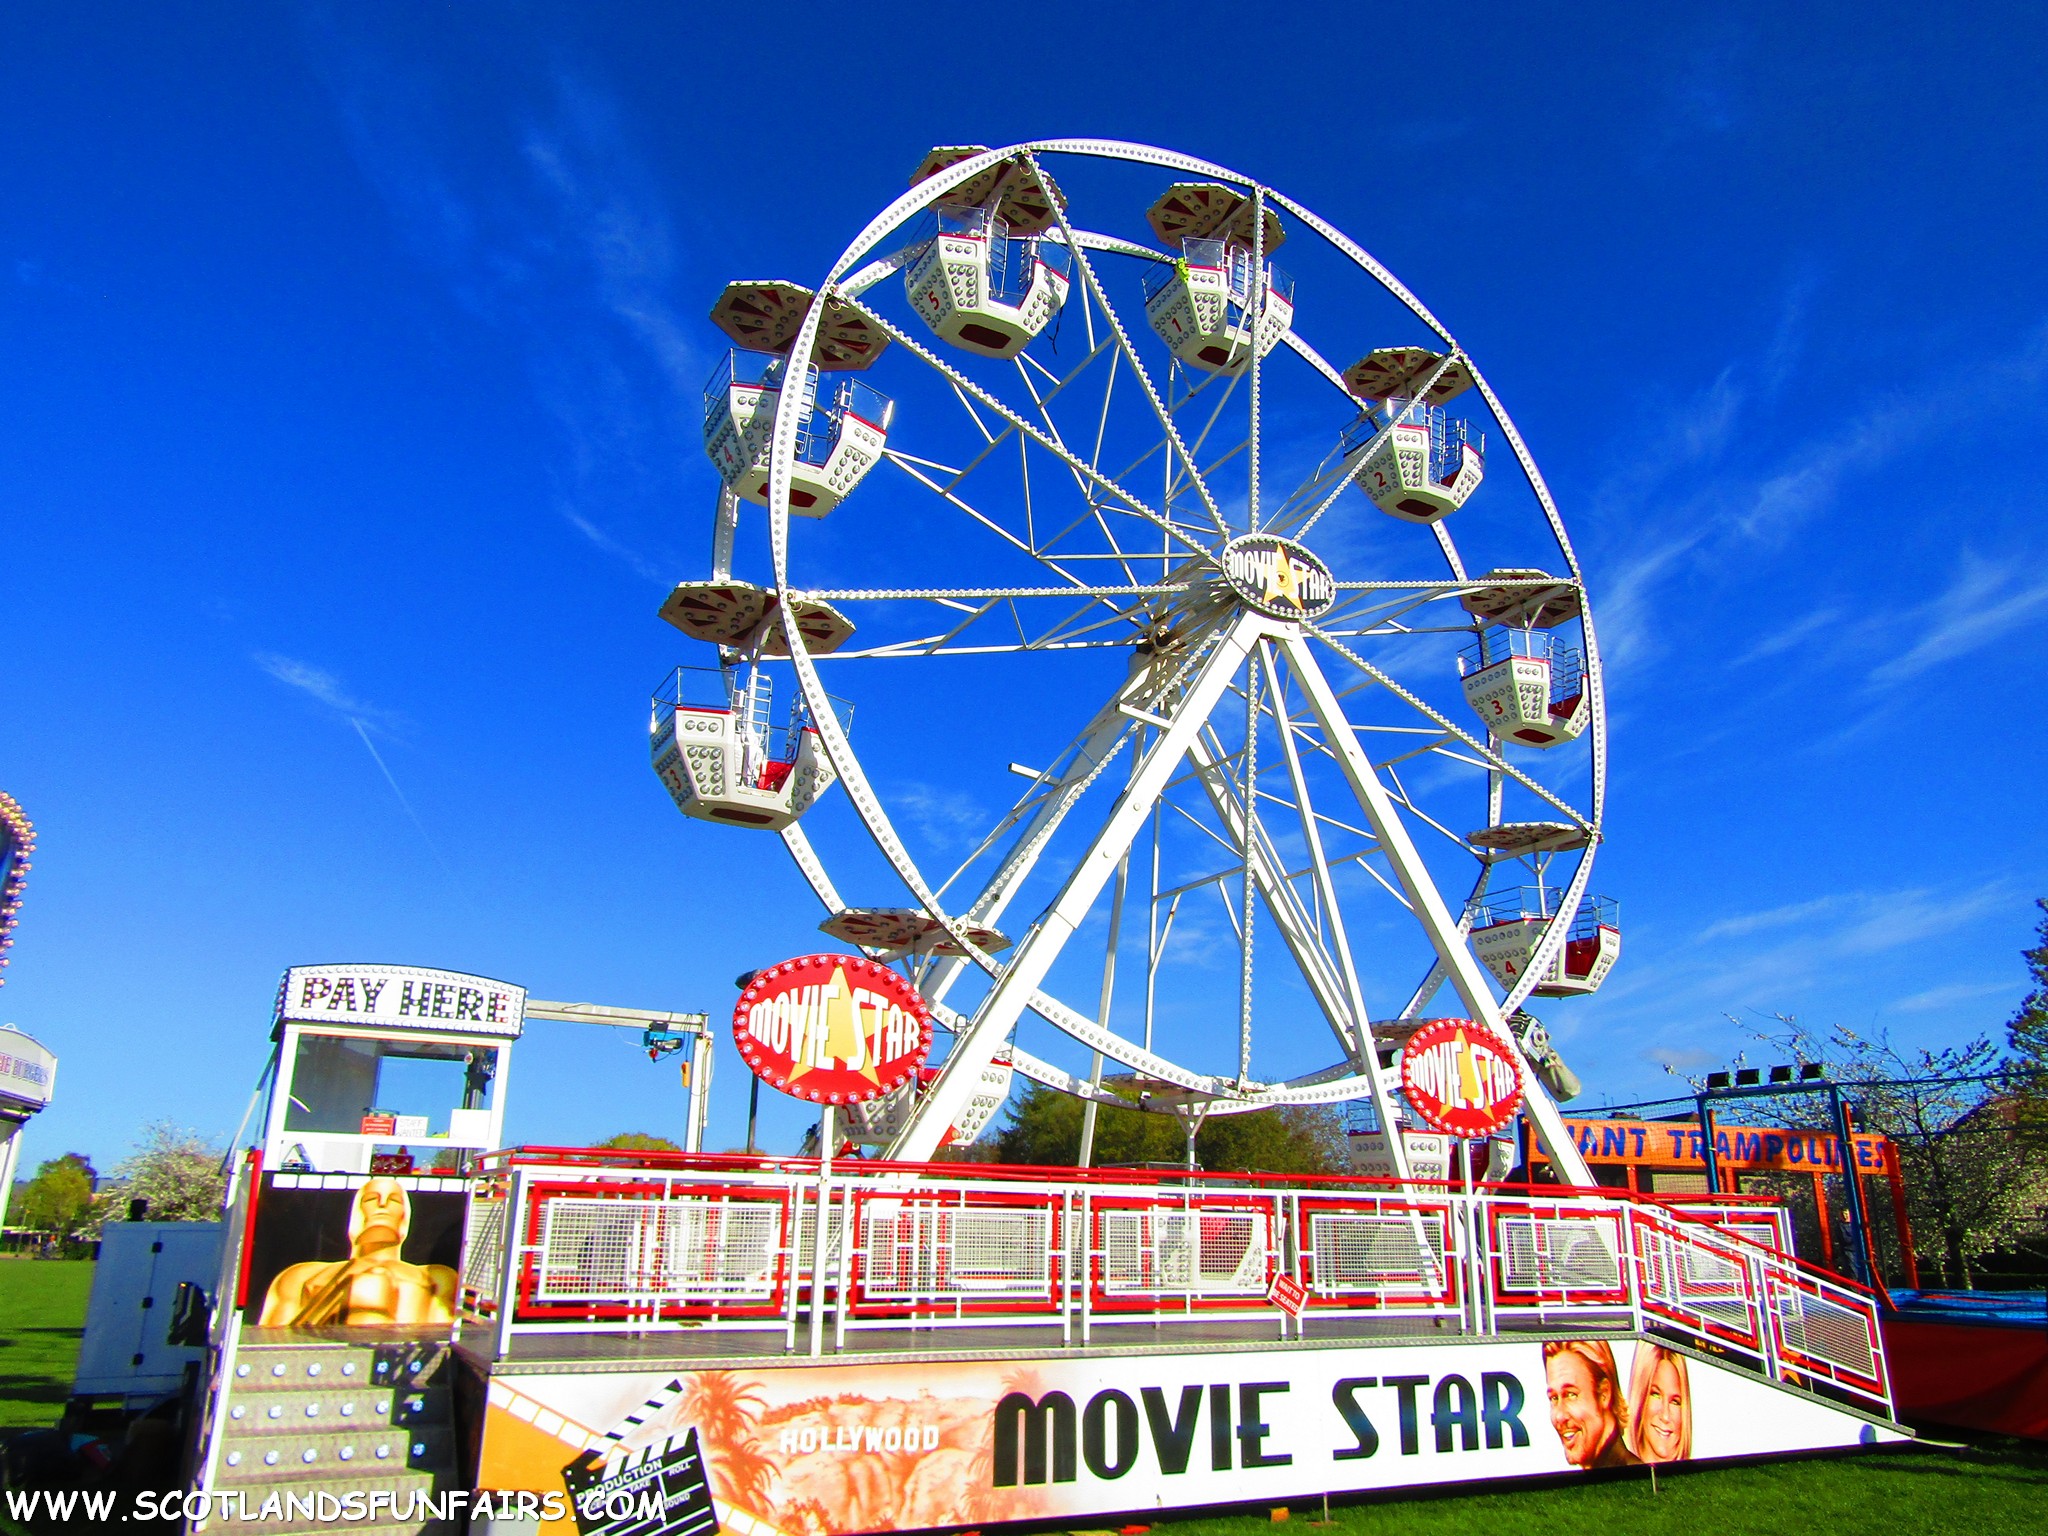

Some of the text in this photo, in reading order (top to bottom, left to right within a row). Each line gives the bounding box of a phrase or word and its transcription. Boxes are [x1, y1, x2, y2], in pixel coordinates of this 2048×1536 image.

[928, 290, 940, 311] 5
[1171, 317, 1182, 333] 1
[723, 445, 734, 464] 4
[1373, 471, 1387, 488] 2
[1230, 549, 1331, 600] MOVIE STAR
[1491, 700, 1504, 716] 3
[669, 769, 682, 790] 3
[1505, 960, 1517, 976] 4
[300, 977, 511, 1024] PAY HERE
[748, 984, 921, 1072] MOVIE STAR
[1410, 1040, 1517, 1110] MOVIE STAR
[1536, 1124, 1647, 1158] ANT
[779, 1424, 940, 1454] HOLLYWOOD
[993, 1371, 1531, 1488] MOVIE STAR
[668, 1461, 692, 1477] ROLL
[575, 1458, 664, 1505] PRODUCTION
[629, 1478, 652, 1494] TAKE
[664, 1492, 691, 1511] SOUND
